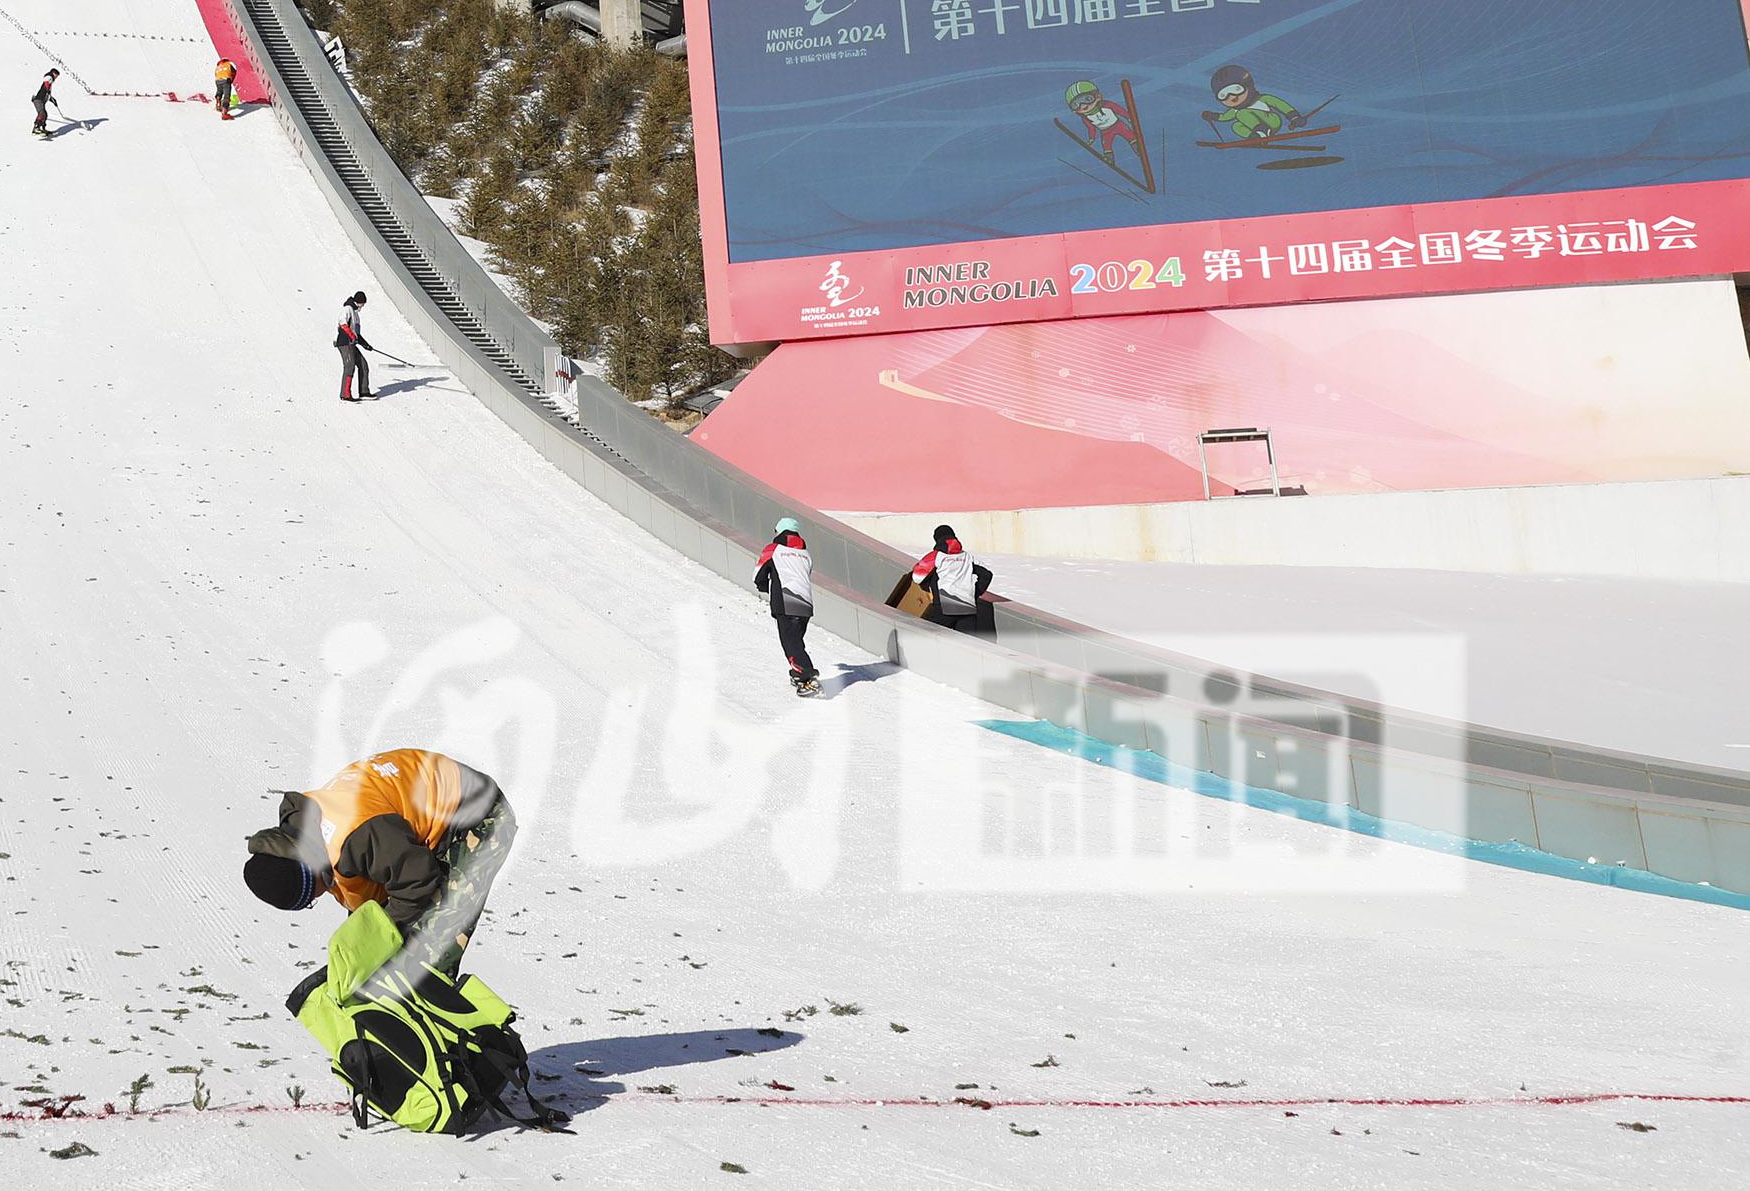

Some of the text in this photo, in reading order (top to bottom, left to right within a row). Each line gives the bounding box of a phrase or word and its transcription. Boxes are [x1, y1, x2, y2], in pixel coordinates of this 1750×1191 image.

[765, 23, 887, 53] MONGOLIA 2024
[767, 26, 804, 41] INNER
[1202, 214, 1698, 283] 第十四届全国冬季运动会
[903, 256, 1186, 310] MONGOLIA 2024
[906, 261, 991, 286] INNER
[801, 306, 827, 315] INNER
[801, 306, 881, 322] MONGOLIA 2024
